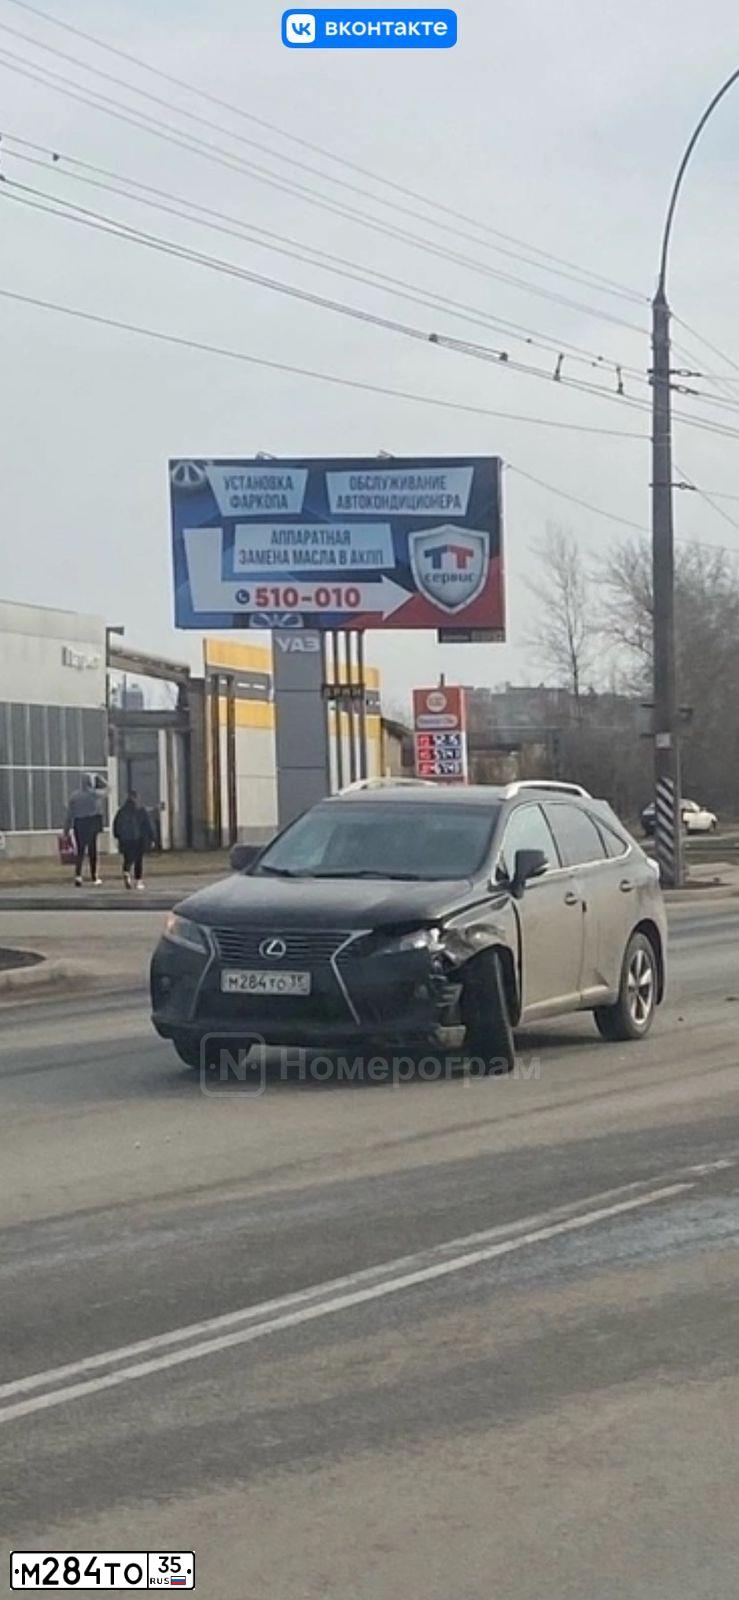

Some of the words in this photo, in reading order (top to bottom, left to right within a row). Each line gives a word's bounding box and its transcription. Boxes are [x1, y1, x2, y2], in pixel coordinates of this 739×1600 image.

[223, 475, 294, 490] УСТАНОВКА
[348, 475, 447, 491] ОБСЛУЖИВАНИЕ
[229, 494, 289, 509] ФАРКОПА
[336, 494, 462, 511] АВТОКОНДИЦИОНЕРА
[271, 530, 351, 545] АППАРАТНАЯ
[238, 550, 290, 566] ЗАМЕНА
[293, 550, 337, 565] МАСЛА
[339, 550, 347, 564] В
[351, 549, 383, 564] АКПП
[255, 587, 361, 608] 510-010
[275, 637, 320, 652] УАЗ
